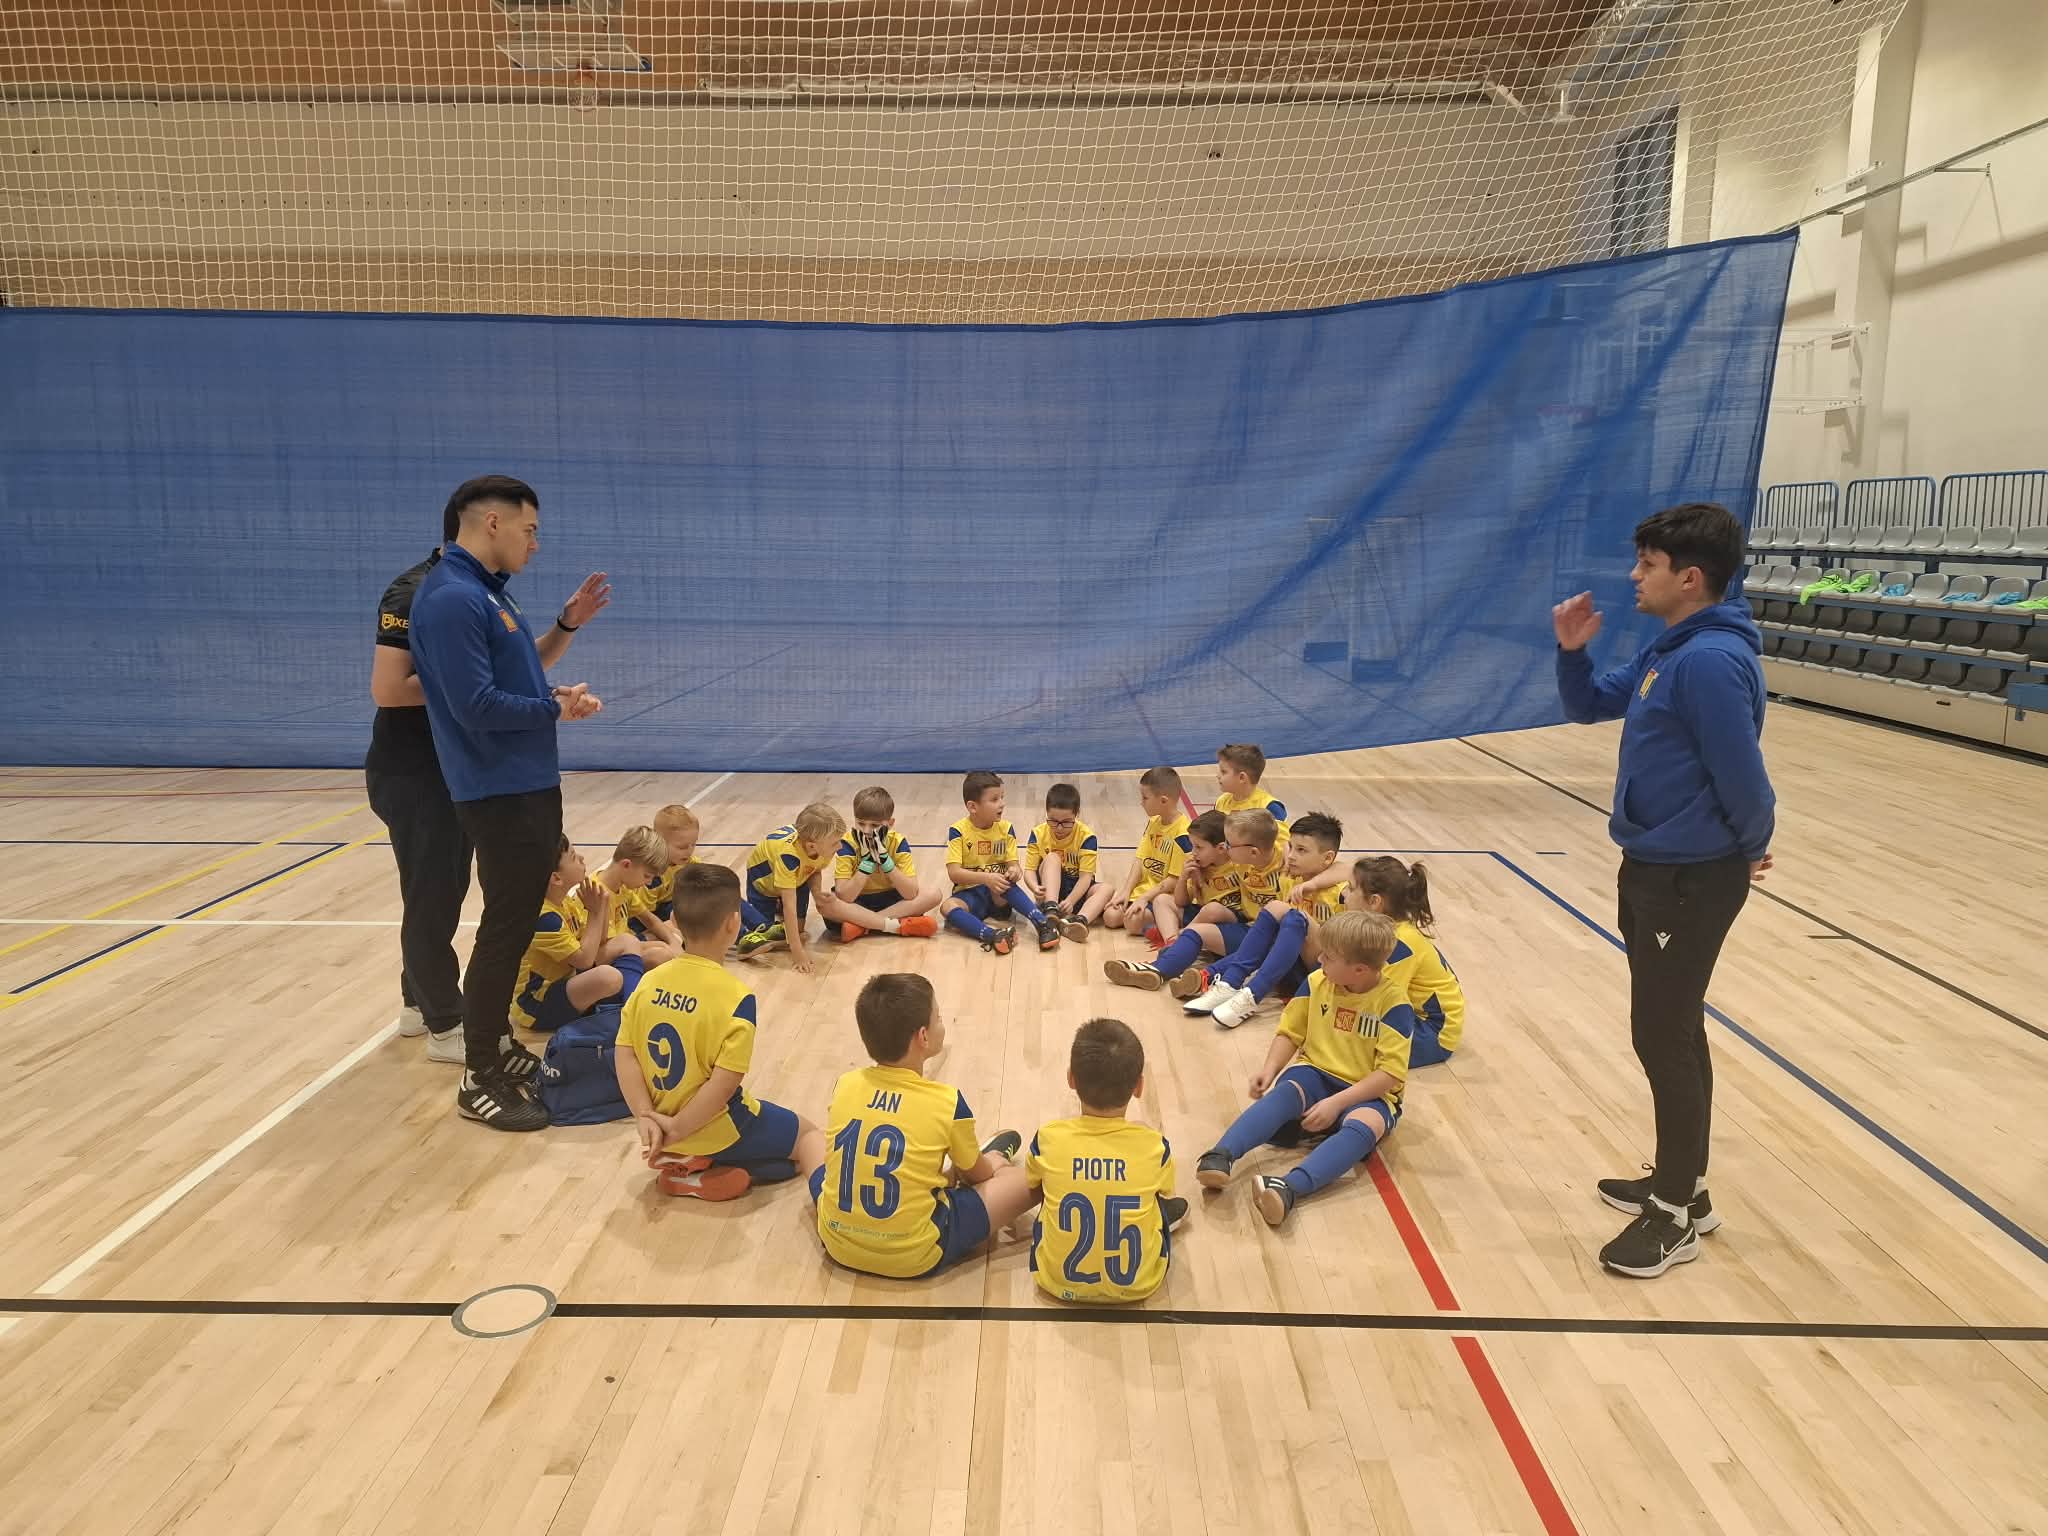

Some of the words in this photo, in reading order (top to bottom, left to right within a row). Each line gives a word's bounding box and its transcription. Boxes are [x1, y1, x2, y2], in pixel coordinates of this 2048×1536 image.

[651, 988, 698, 1014] JASIO
[647, 1022, 687, 1092] 9
[866, 1089, 903, 1114] JAN
[833, 1118, 906, 1219] 13
[1072, 1157, 1127, 1182] PIOTR
[1058, 1191, 1142, 1286] 25
